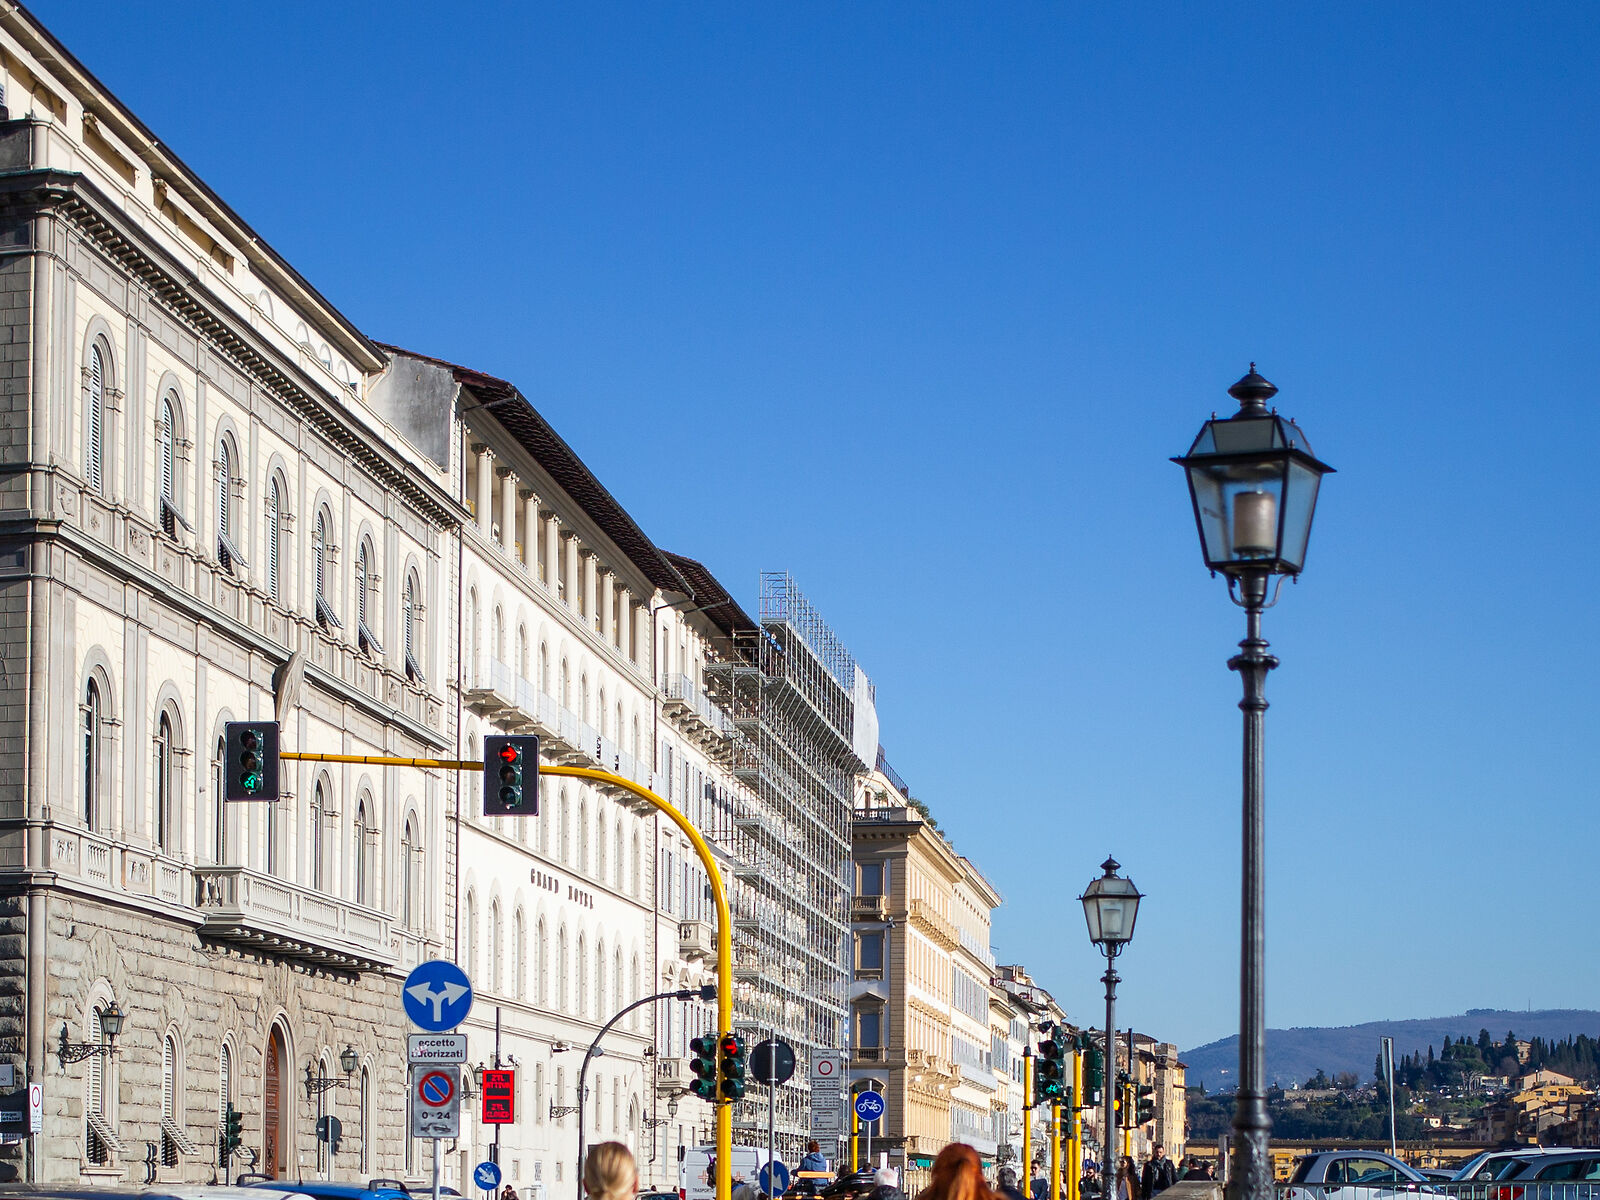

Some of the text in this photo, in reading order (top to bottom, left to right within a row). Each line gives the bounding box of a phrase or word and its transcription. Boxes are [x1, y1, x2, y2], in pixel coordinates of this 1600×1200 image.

[530, 868, 593, 909] GRAND HOTEL
[491, 1074, 504, 1082] ZTL
[491, 1103, 504, 1111] ZTL
